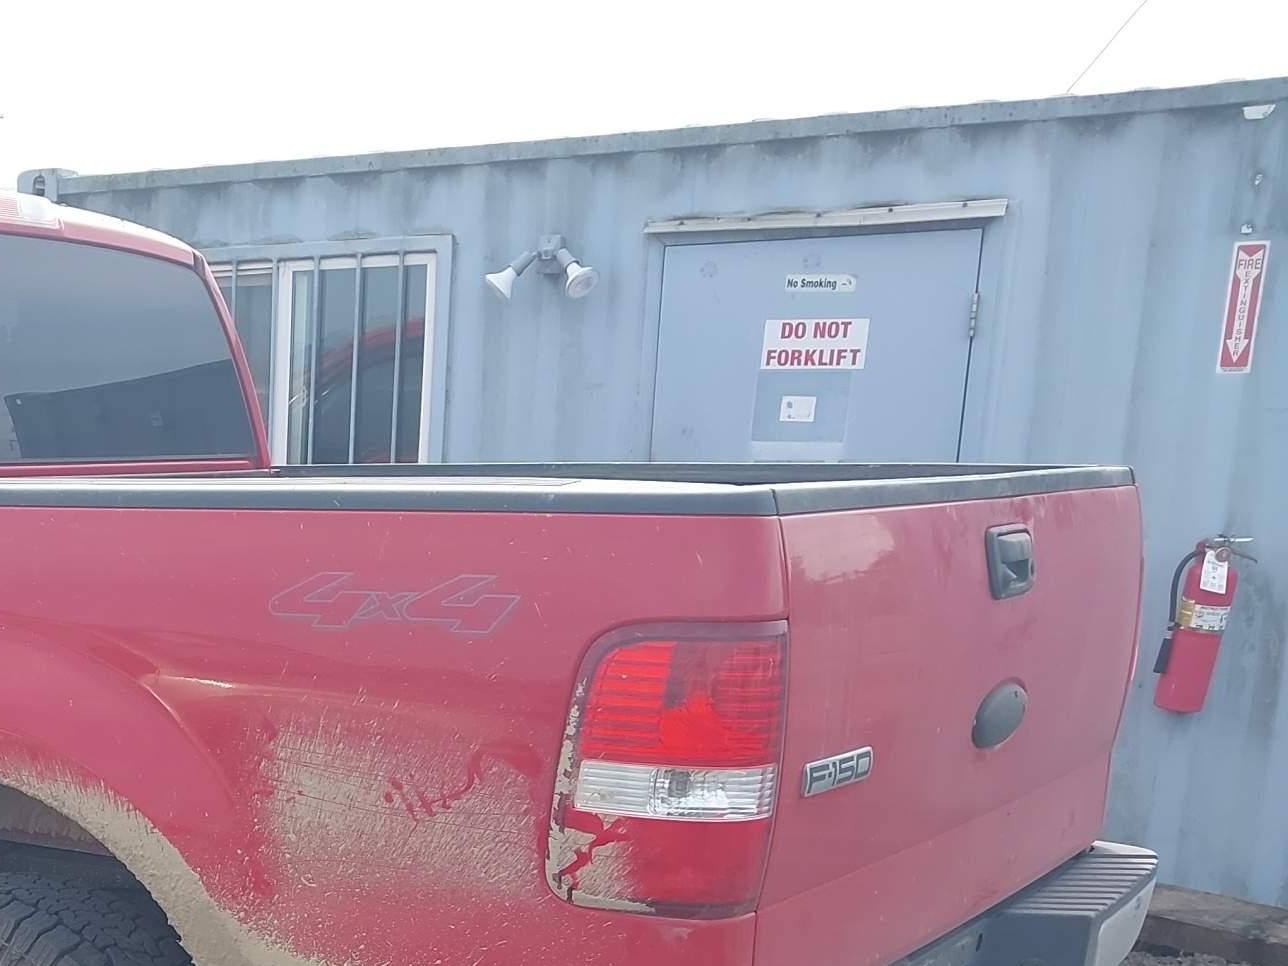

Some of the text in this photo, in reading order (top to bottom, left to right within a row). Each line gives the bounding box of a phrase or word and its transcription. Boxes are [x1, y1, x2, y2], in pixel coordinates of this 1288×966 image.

[1237, 258, 1262, 270] FIRE
[786, 278, 837, 290] No Smoking
[1232, 270, 1252, 356] EXTINGUISHER
[780, 321, 852, 340] DO NOT
[765, 348, 861, 366] FORKLIFT
